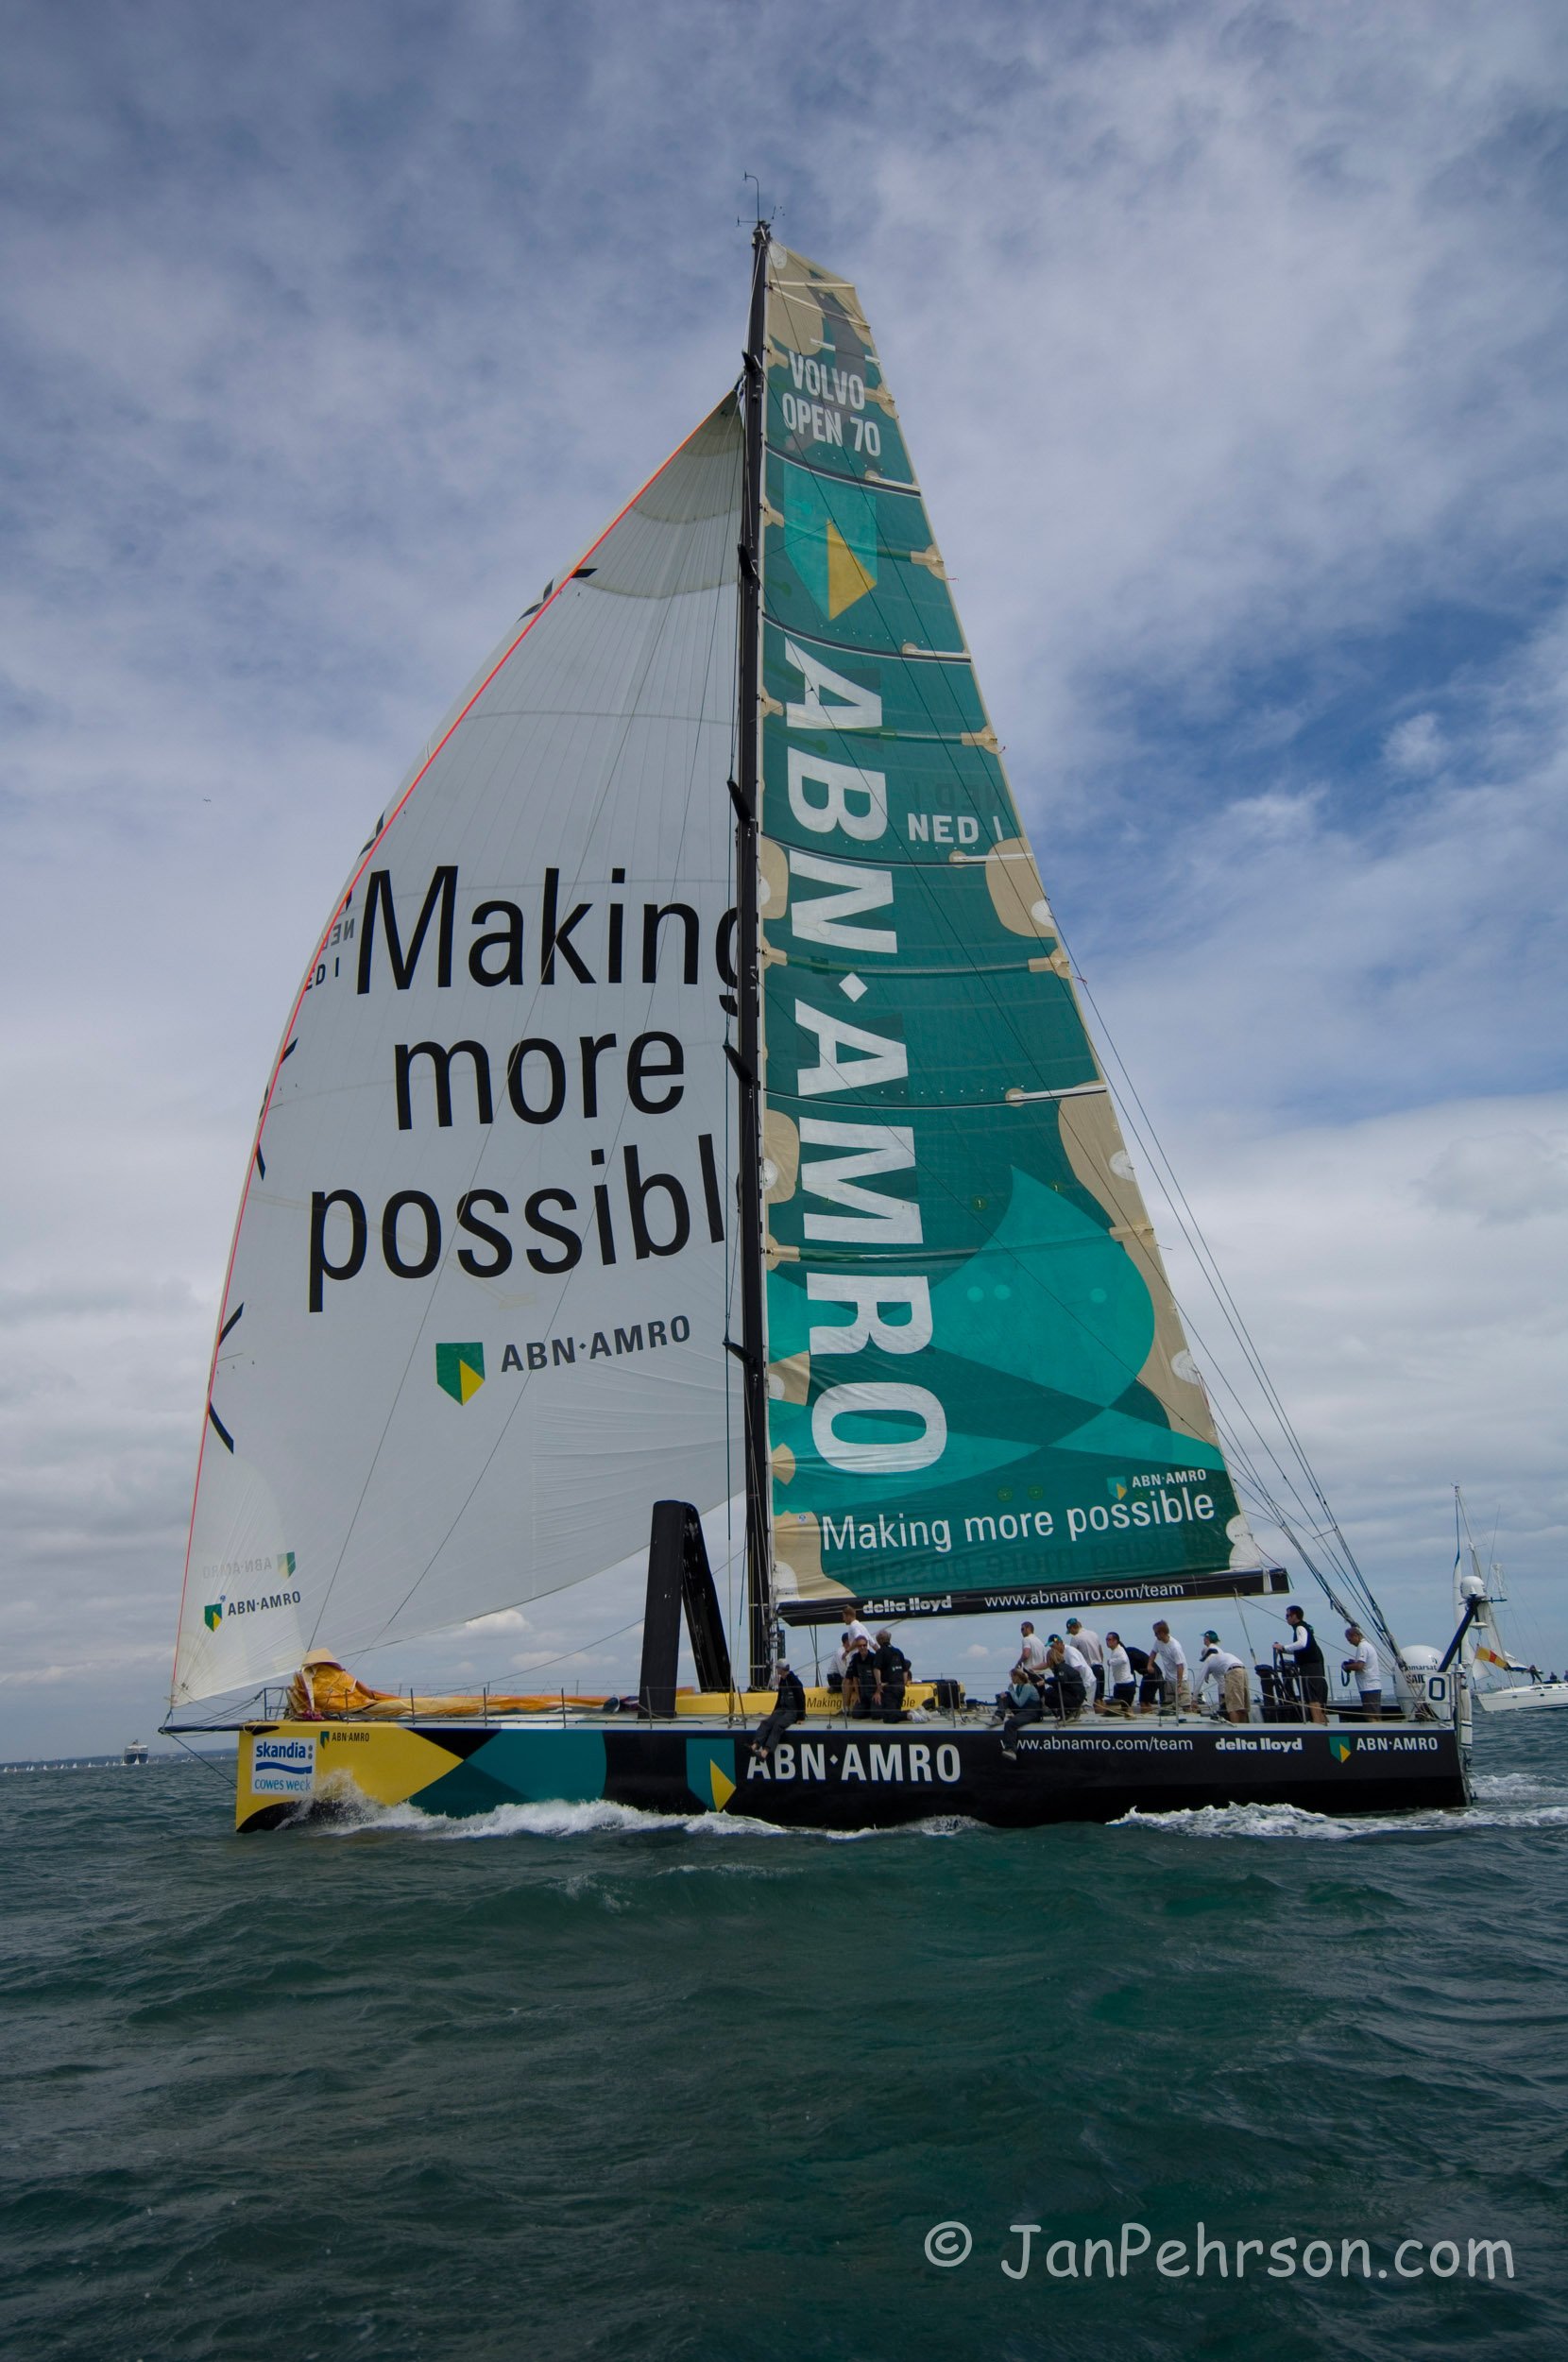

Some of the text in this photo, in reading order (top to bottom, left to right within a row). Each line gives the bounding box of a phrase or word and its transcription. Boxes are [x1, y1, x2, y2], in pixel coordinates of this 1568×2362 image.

[788, 351, 865, 410] VOLVO
[782, 392, 881, 456] OPEN 70
[908, 813, 980, 844] NED
[357, 865, 759, 1018] Making
[394, 1031, 686, 1131] more
[309, 1133, 740, 1313] possibl
[822, 1486, 1215, 1552] Making more possible
[863, 1595, 952, 1615] delta lloyd
[985, 1582, 1185, 1608] www.abnamro.com/team
[807, 1697, 843, 1710] Making
[1000, 1736, 1194, 1753] ww.abnamro.com/team
[1215, 1737, 1303, 1754] delta lloyd
[254, 1778, 284, 1790] cowes
